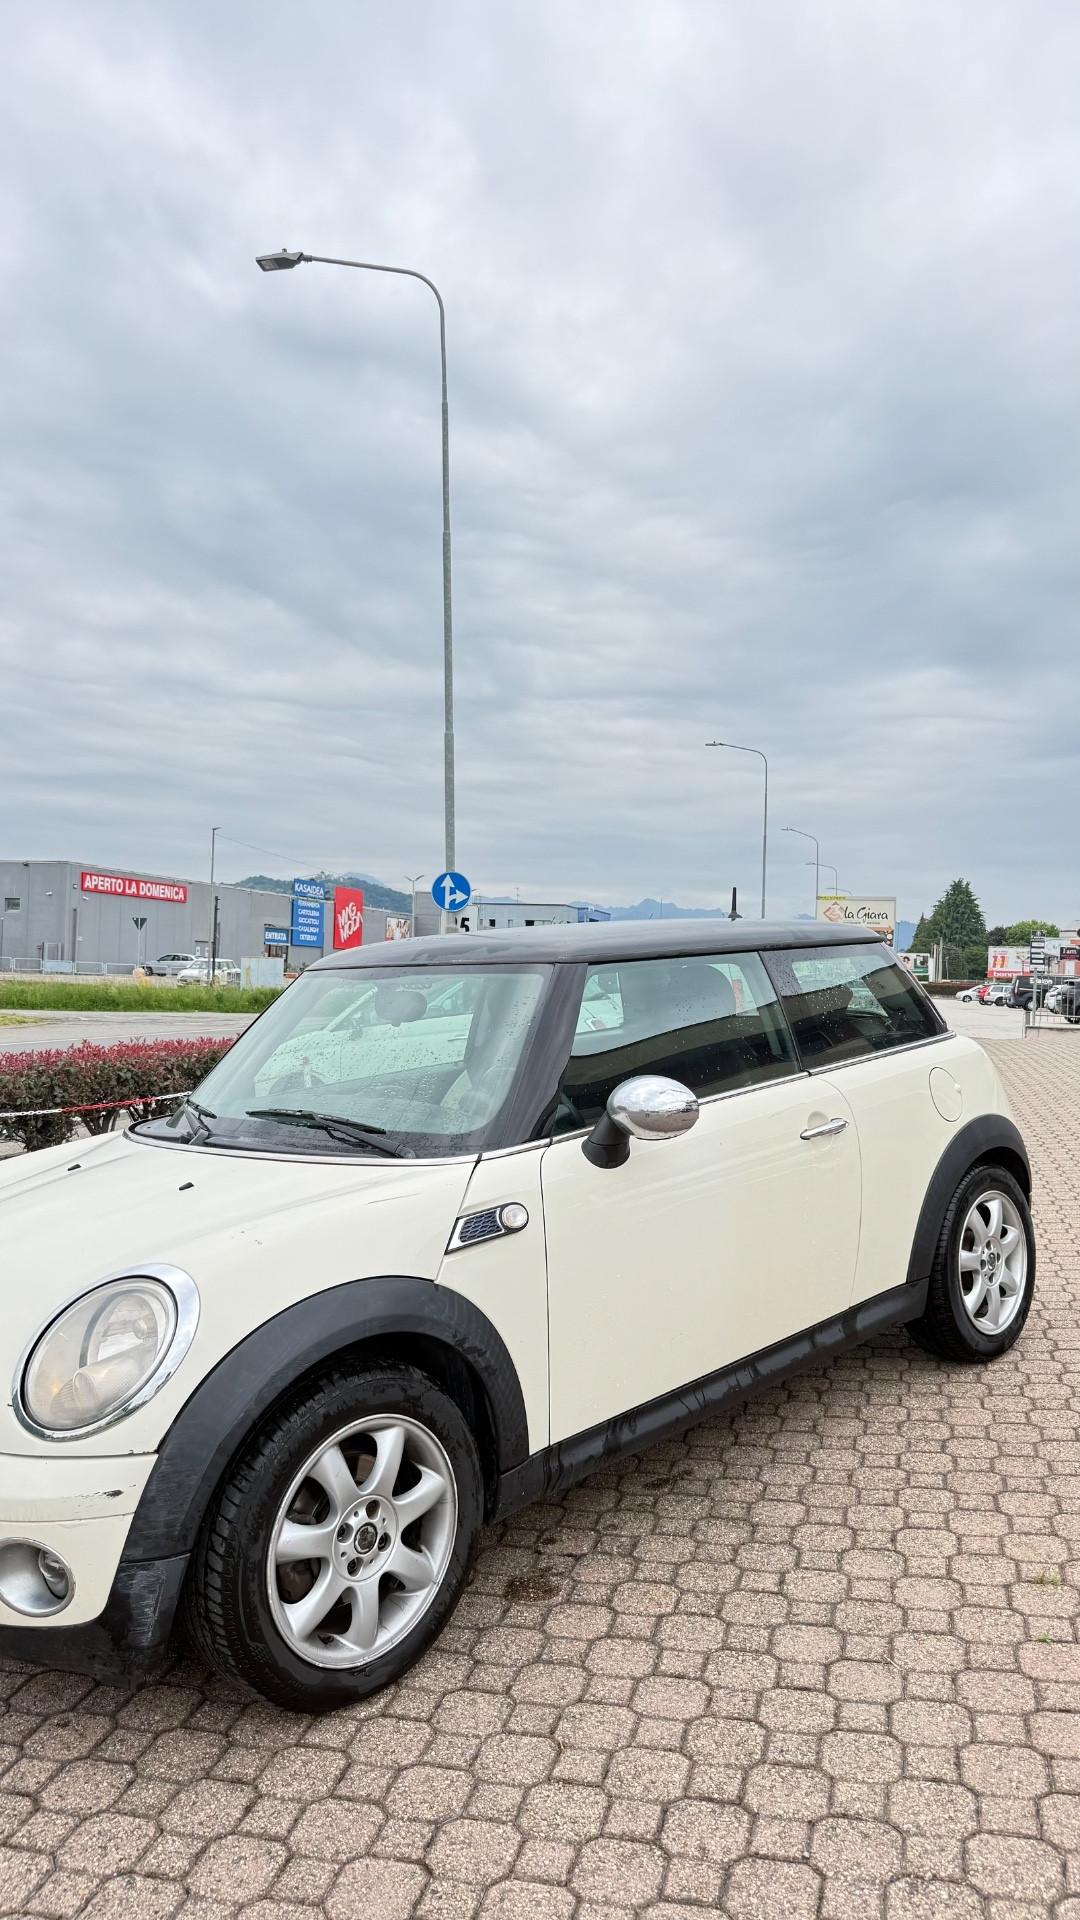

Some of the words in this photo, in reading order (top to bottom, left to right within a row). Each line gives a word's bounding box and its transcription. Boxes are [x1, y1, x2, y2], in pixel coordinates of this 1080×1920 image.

[84, 874, 124, 892] APERTO
[125, 880, 137, 894] LA
[139, 882, 185, 901] DOMENICA
[294, 882, 324, 896] KASAIDEA
[844, 905, 855, 919] la
[856, 906, 889, 923] Giara
[265, 931, 287, 941] ENTRATA
